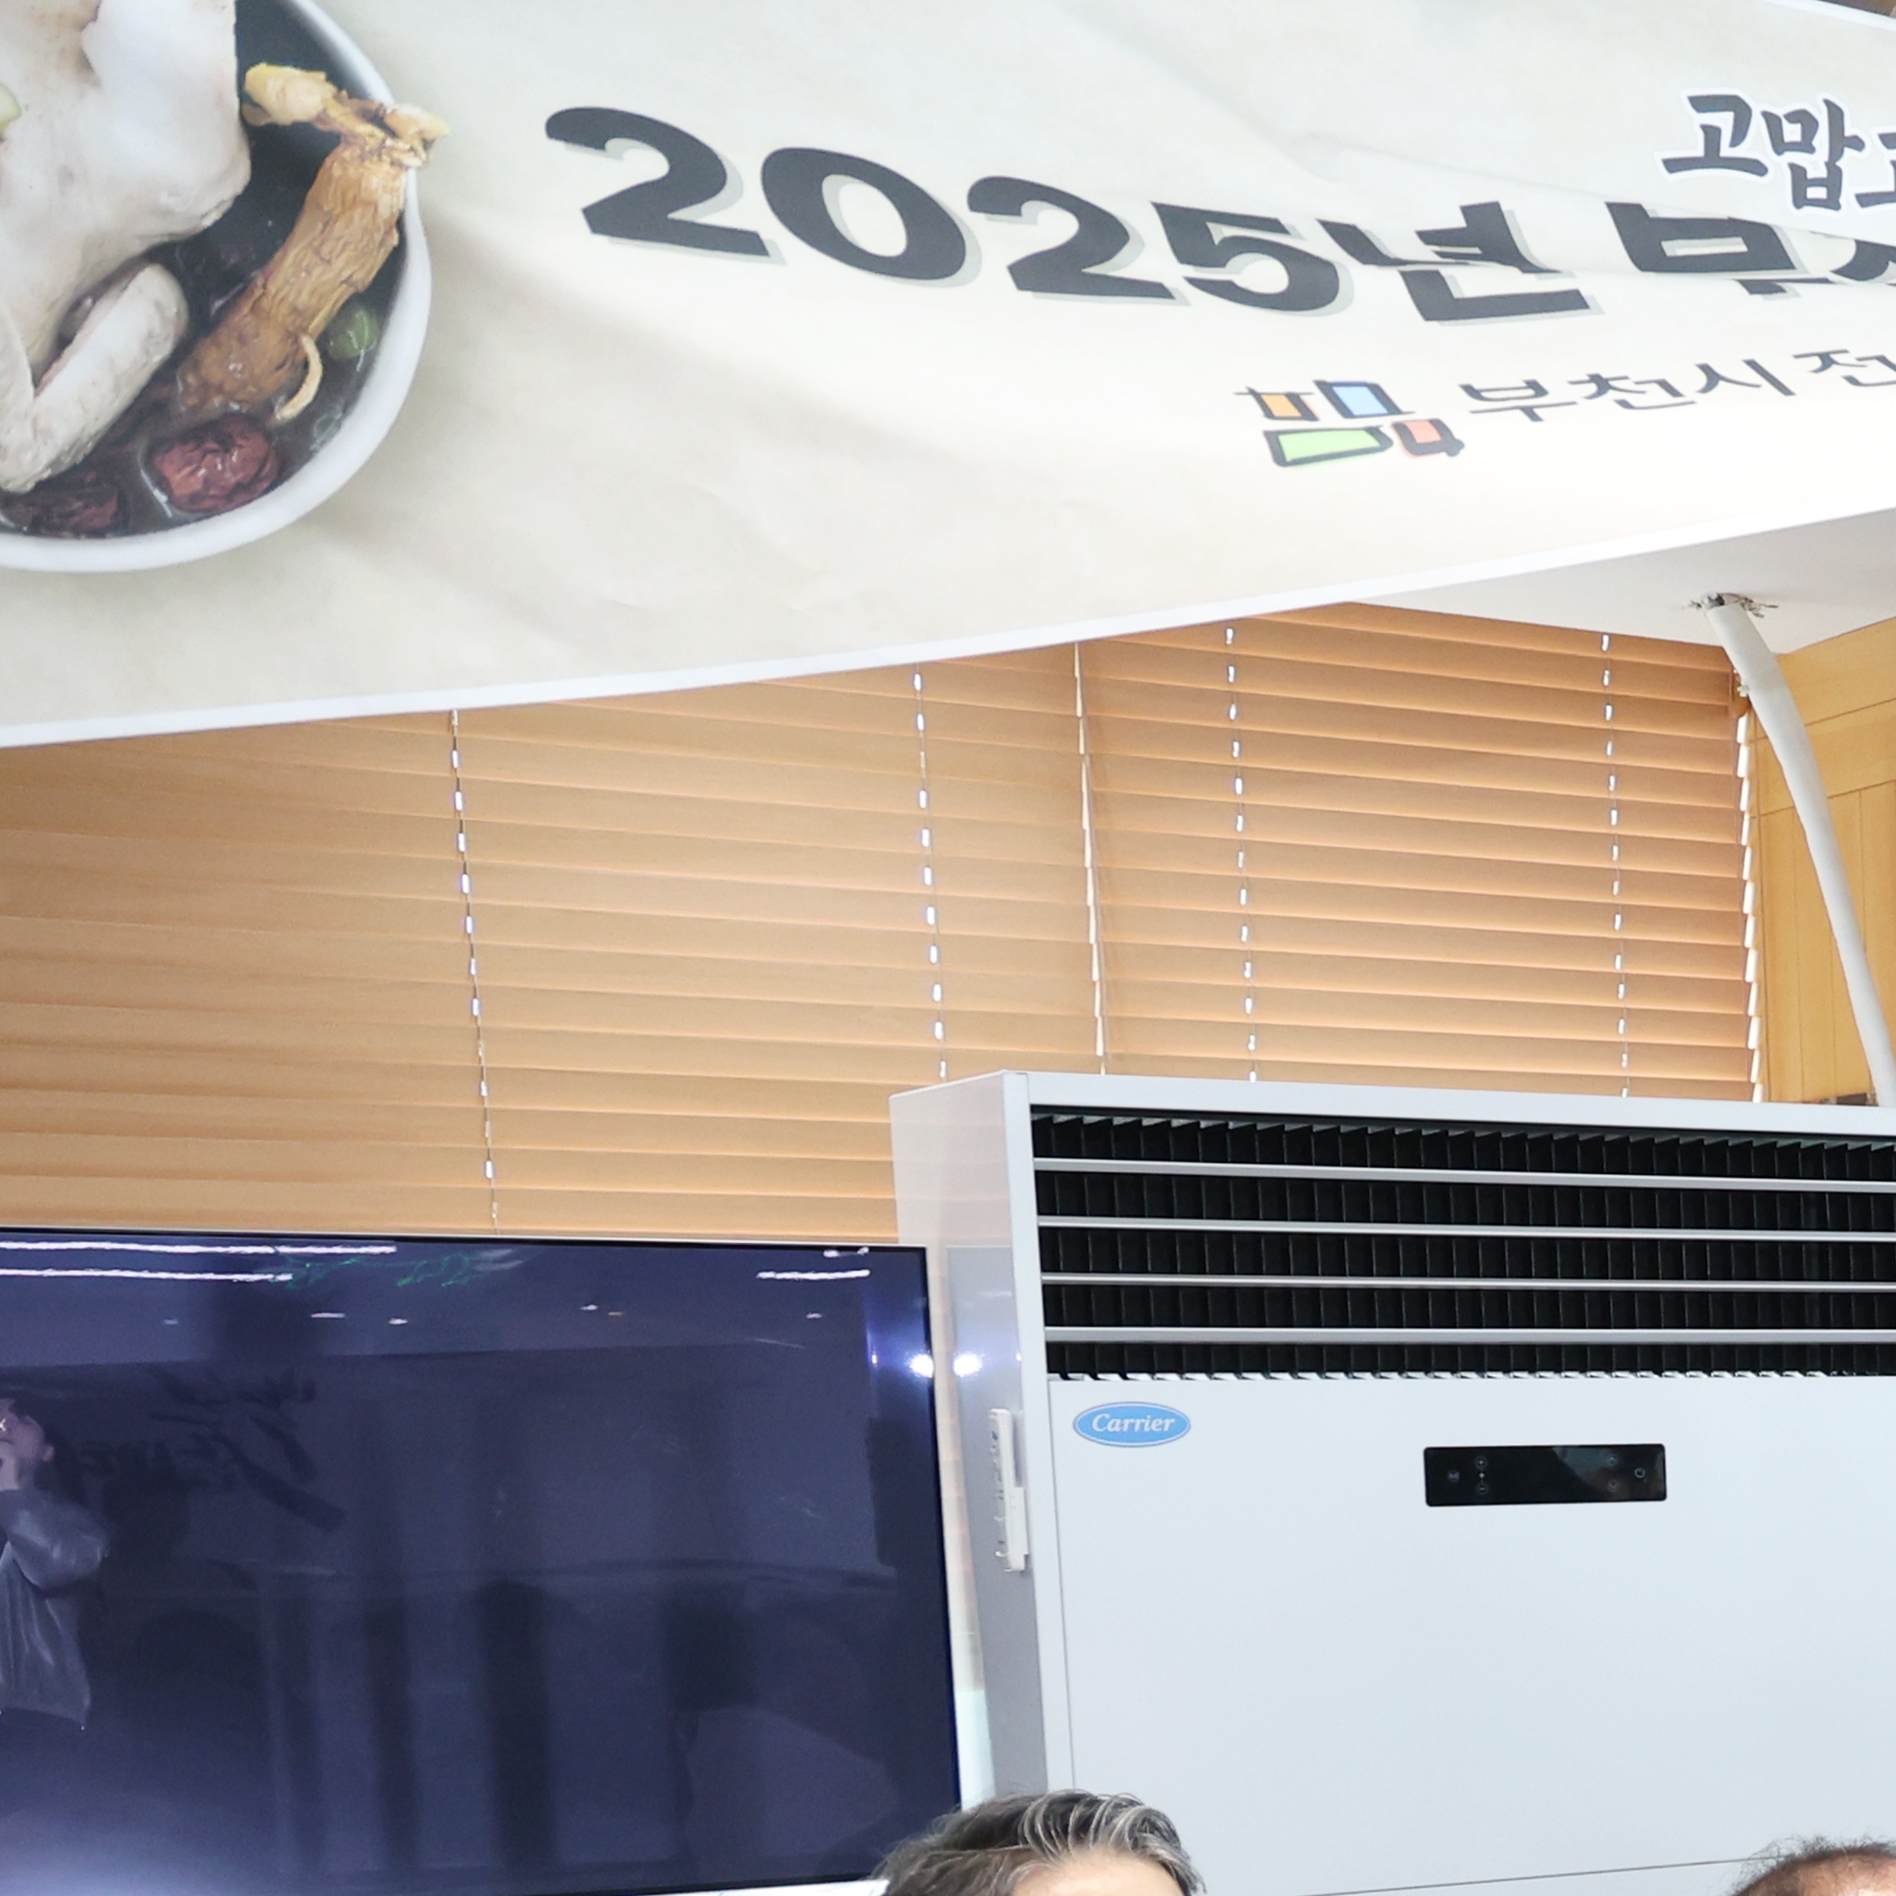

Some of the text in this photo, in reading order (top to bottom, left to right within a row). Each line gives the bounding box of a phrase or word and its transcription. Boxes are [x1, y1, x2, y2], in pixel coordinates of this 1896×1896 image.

[545, 106, 1592, 321] 2025년
[1459, 358, 1796, 422] 부천시
[1091, 1413, 1176, 1432] Carrier
